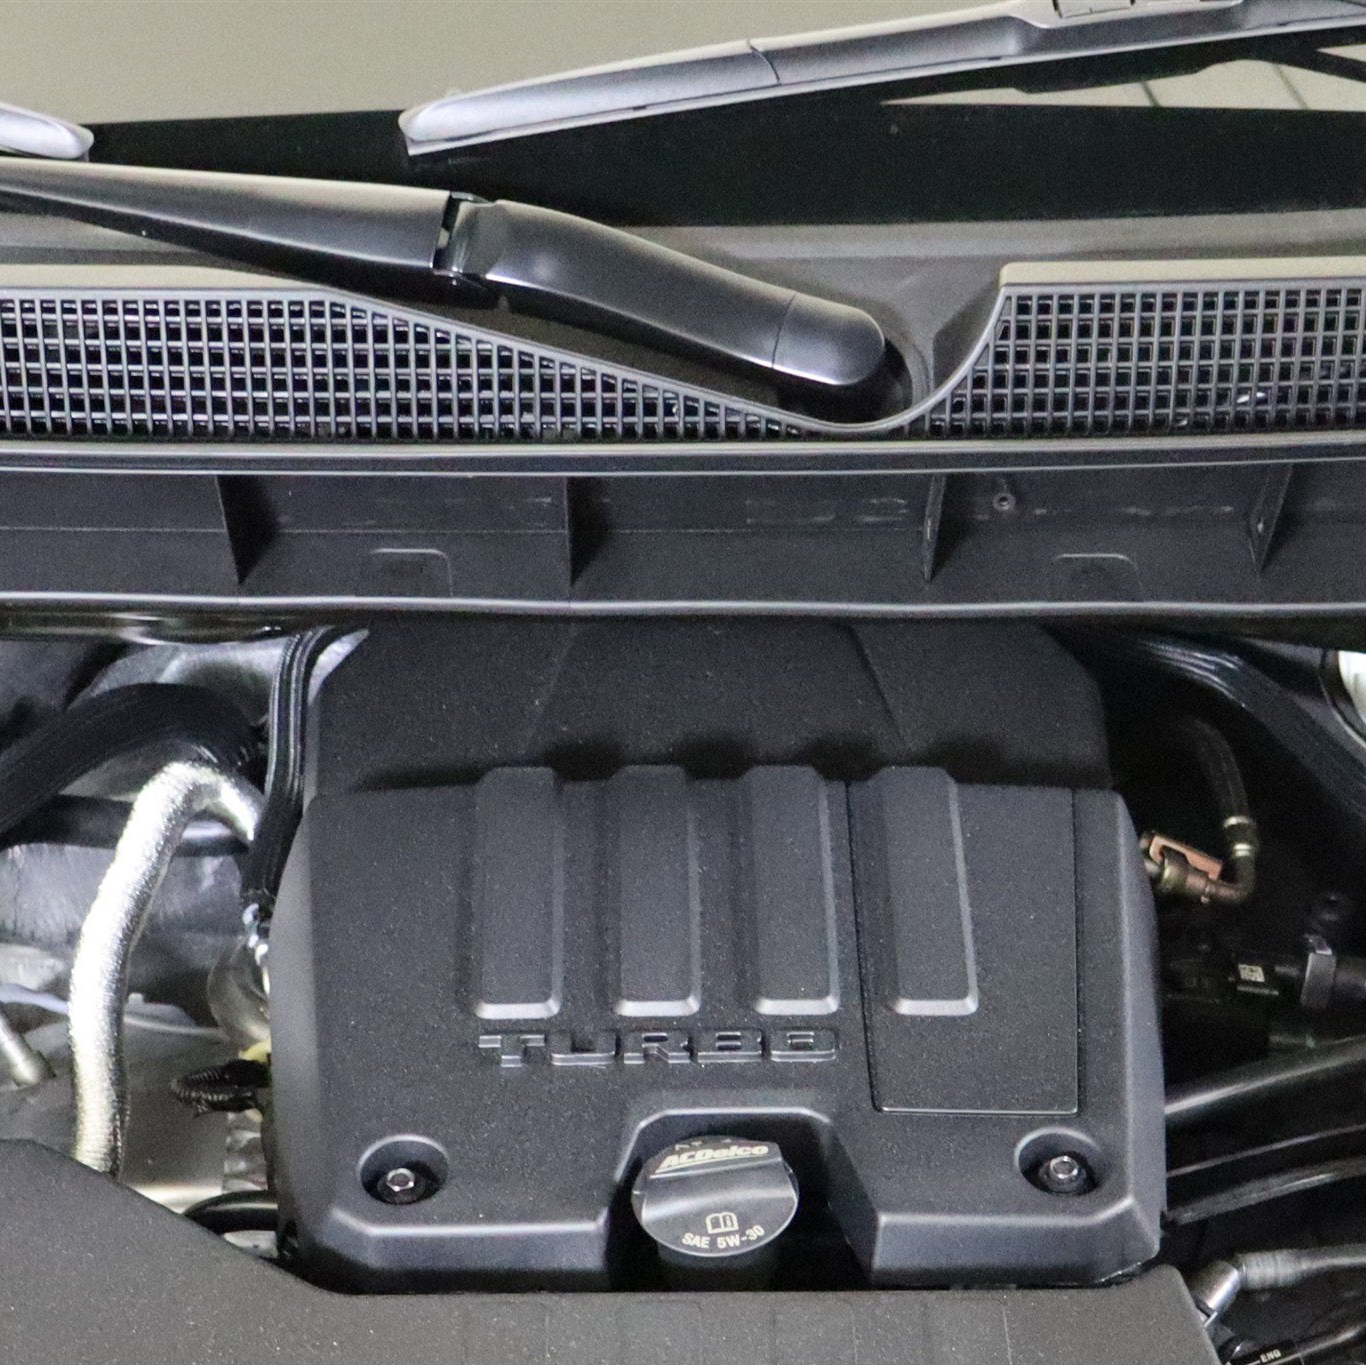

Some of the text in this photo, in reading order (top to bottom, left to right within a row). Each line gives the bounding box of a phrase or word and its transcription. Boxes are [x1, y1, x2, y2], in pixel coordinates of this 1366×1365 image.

[477, 1029, 837, 1068] TURBO
[655, 1145, 769, 1173] ACDelco
[682, 1224, 766, 1249] SAE 5W-30
[1259, 1348, 1282, 1363] ENG
